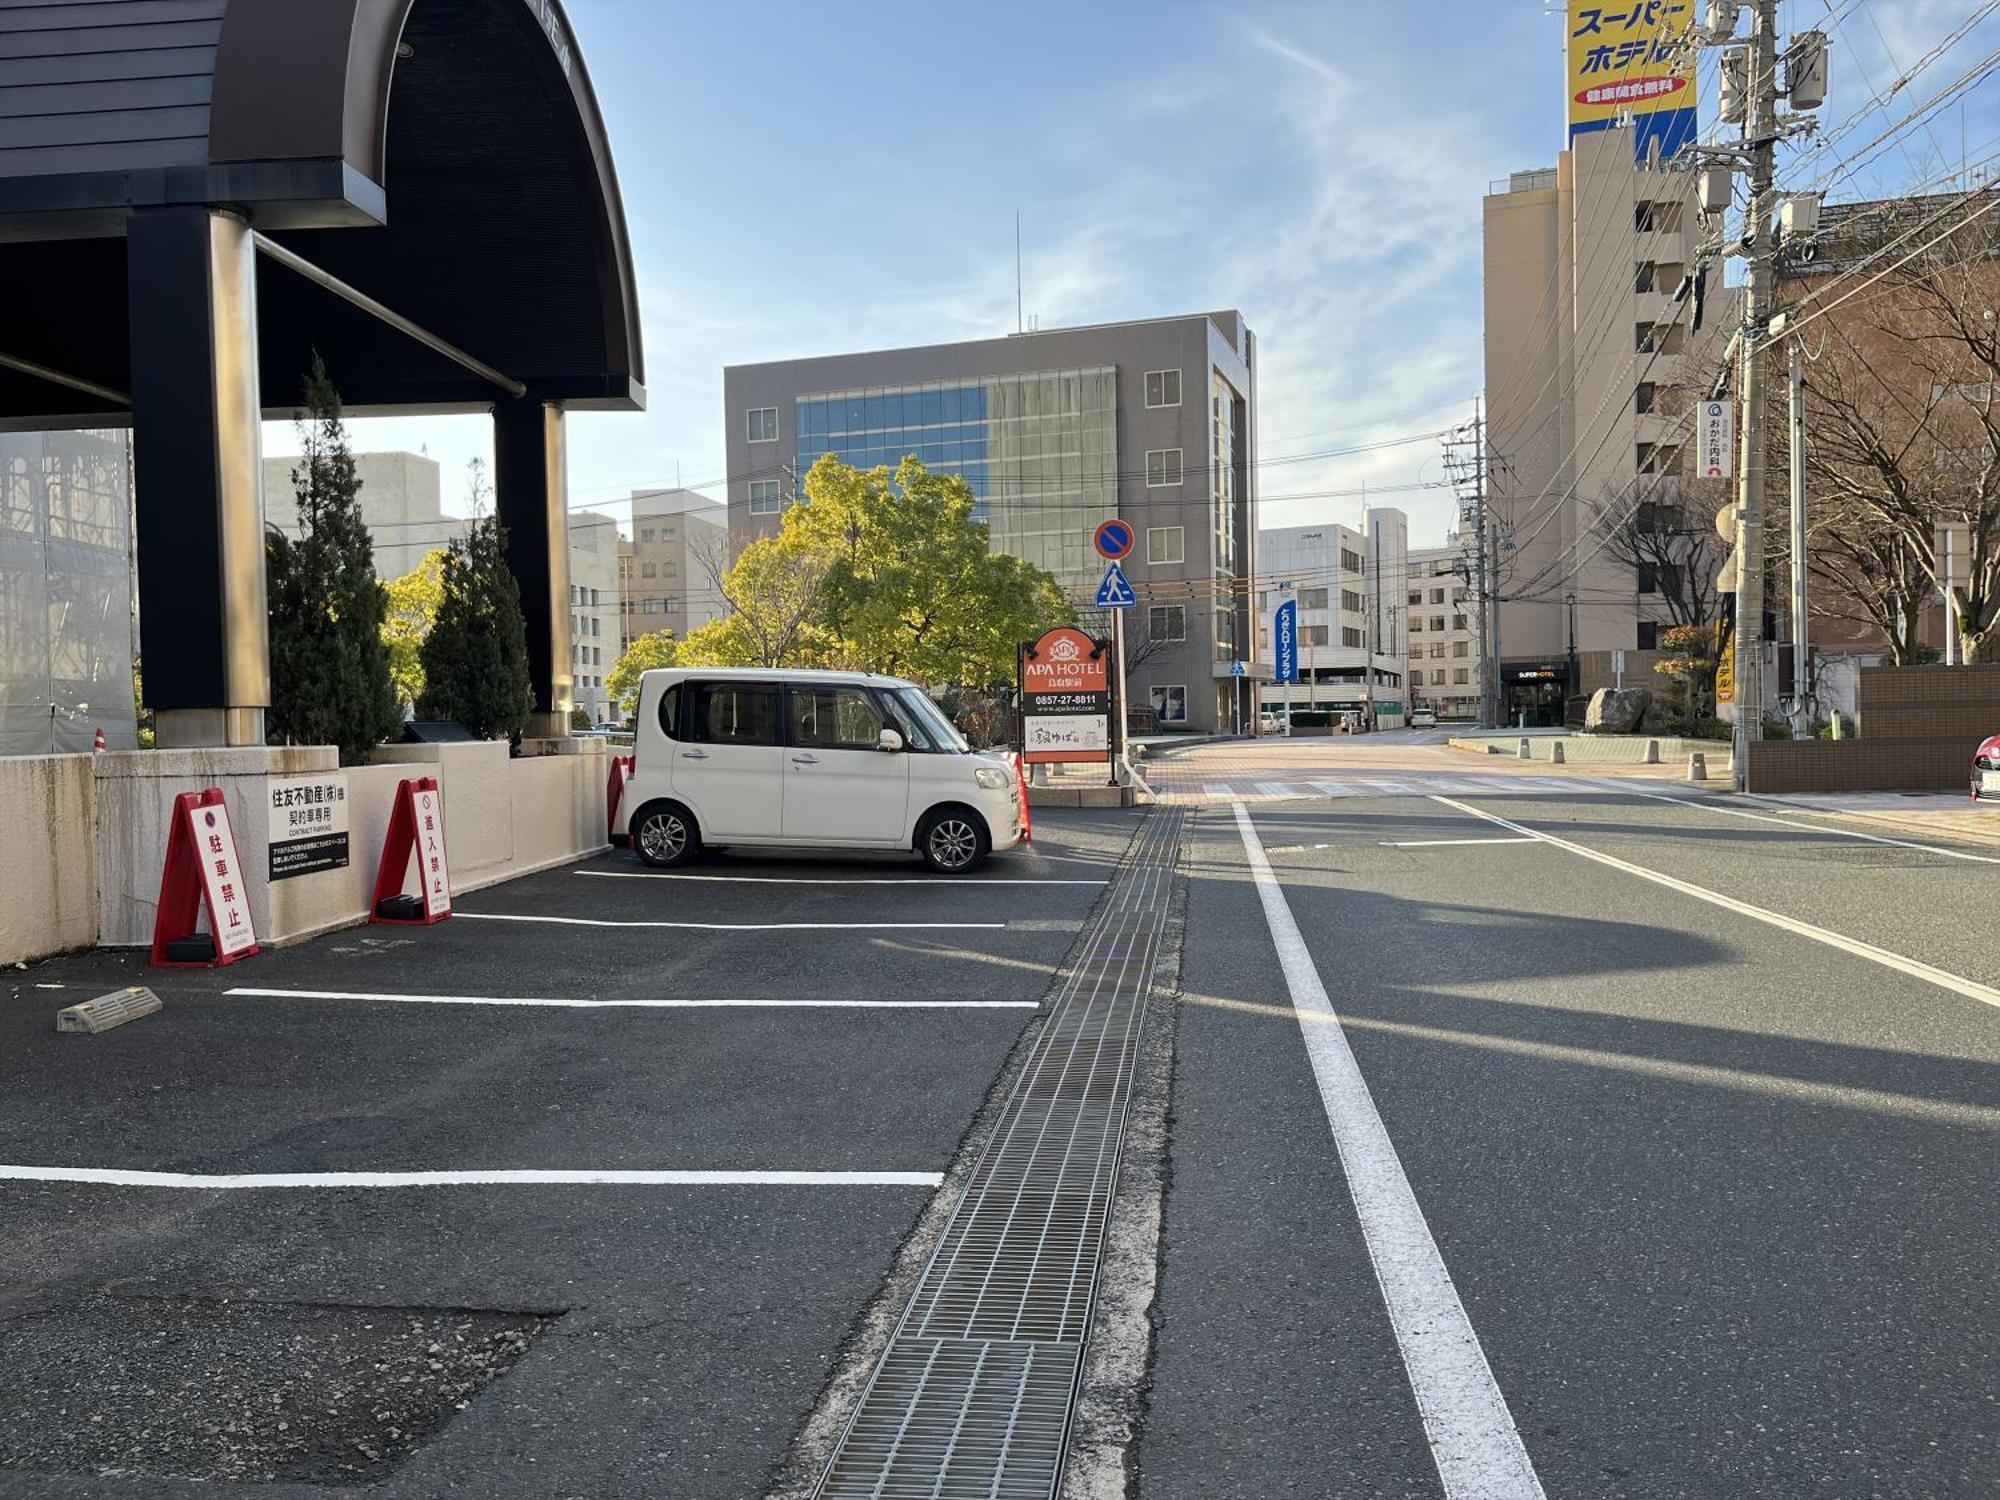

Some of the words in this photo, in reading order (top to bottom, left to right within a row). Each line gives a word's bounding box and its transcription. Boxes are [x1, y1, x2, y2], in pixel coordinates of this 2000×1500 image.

[1572, 1, 1686, 38] スーパー
[1579, 39, 1674, 75] ホテル
[1026, 664, 1054, 676] APA
[1057, 663, 1103, 675] HOTEL
[1035, 695, 1096, 705] 0857-27-8811
[424, 816, 442, 894] 進入禁止
[208, 834, 241, 928] 駐車禁止
